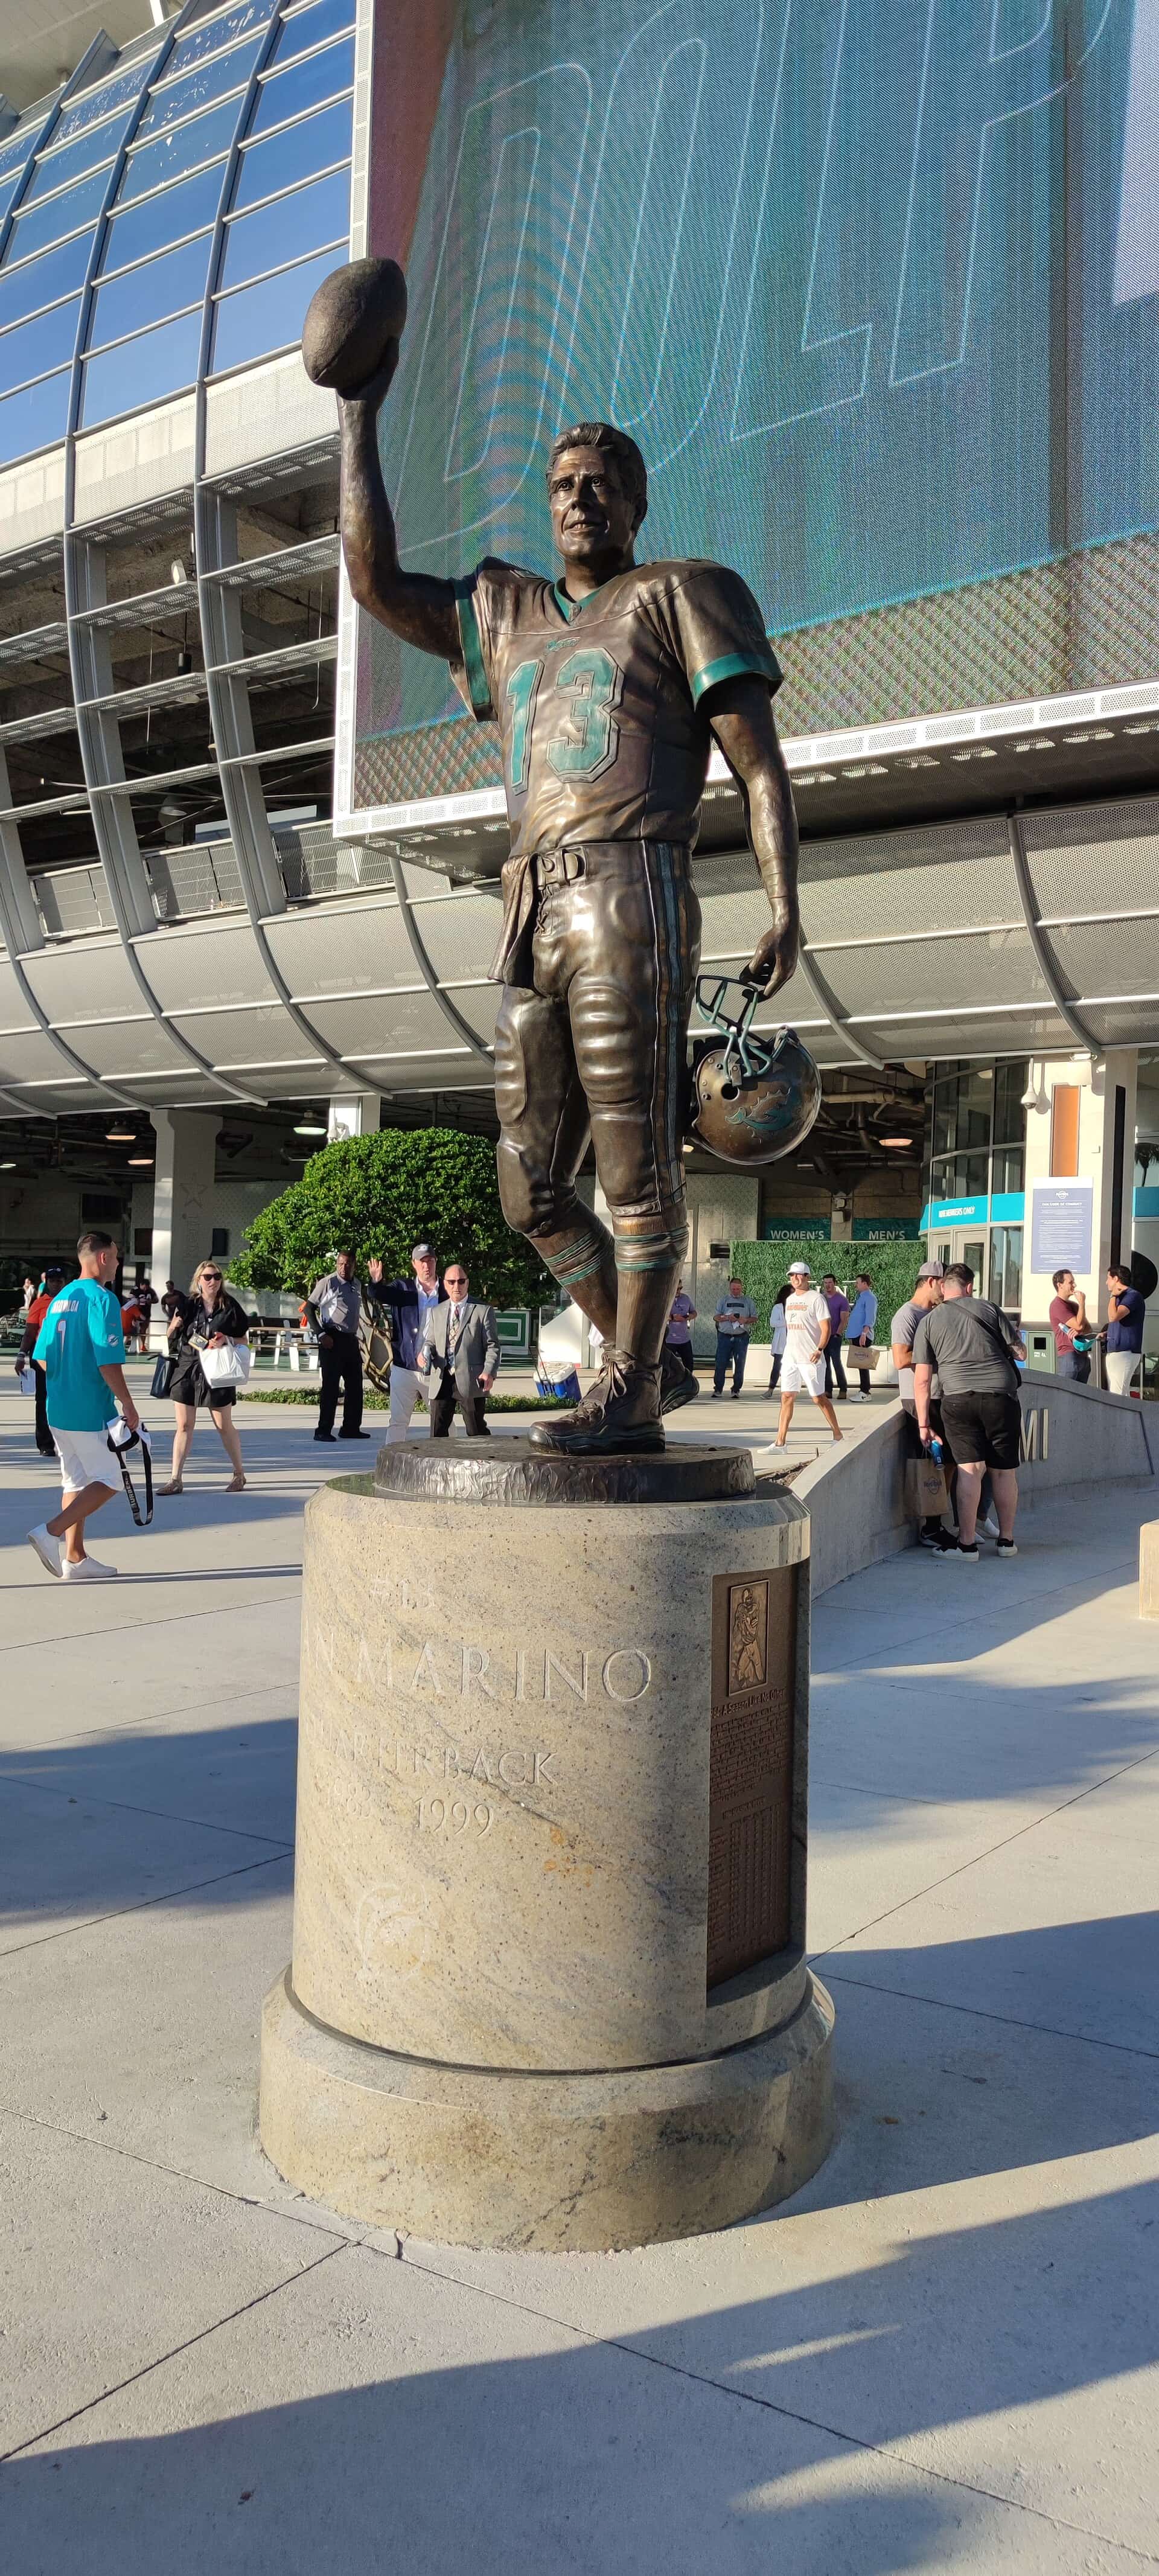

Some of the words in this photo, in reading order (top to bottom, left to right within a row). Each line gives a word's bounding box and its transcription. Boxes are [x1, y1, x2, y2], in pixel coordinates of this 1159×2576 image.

[505, 647, 624, 796] 13
[963, 1206, 975, 1215] ONLY
[770, 1230, 825, 1240] WOMEN'S
[869, 1230, 905, 1240] MEN'S
[57, 1318, 66, 1356] 1
[356, 1632, 653, 1702] MARINO
[723, 1705, 728, 1716] A
[729, 1700, 748, 1714] Season
[749, 1695, 761, 1707] Like
[762, 1692, 770, 1702] No
[413, 1797, 493, 1836] 1999
